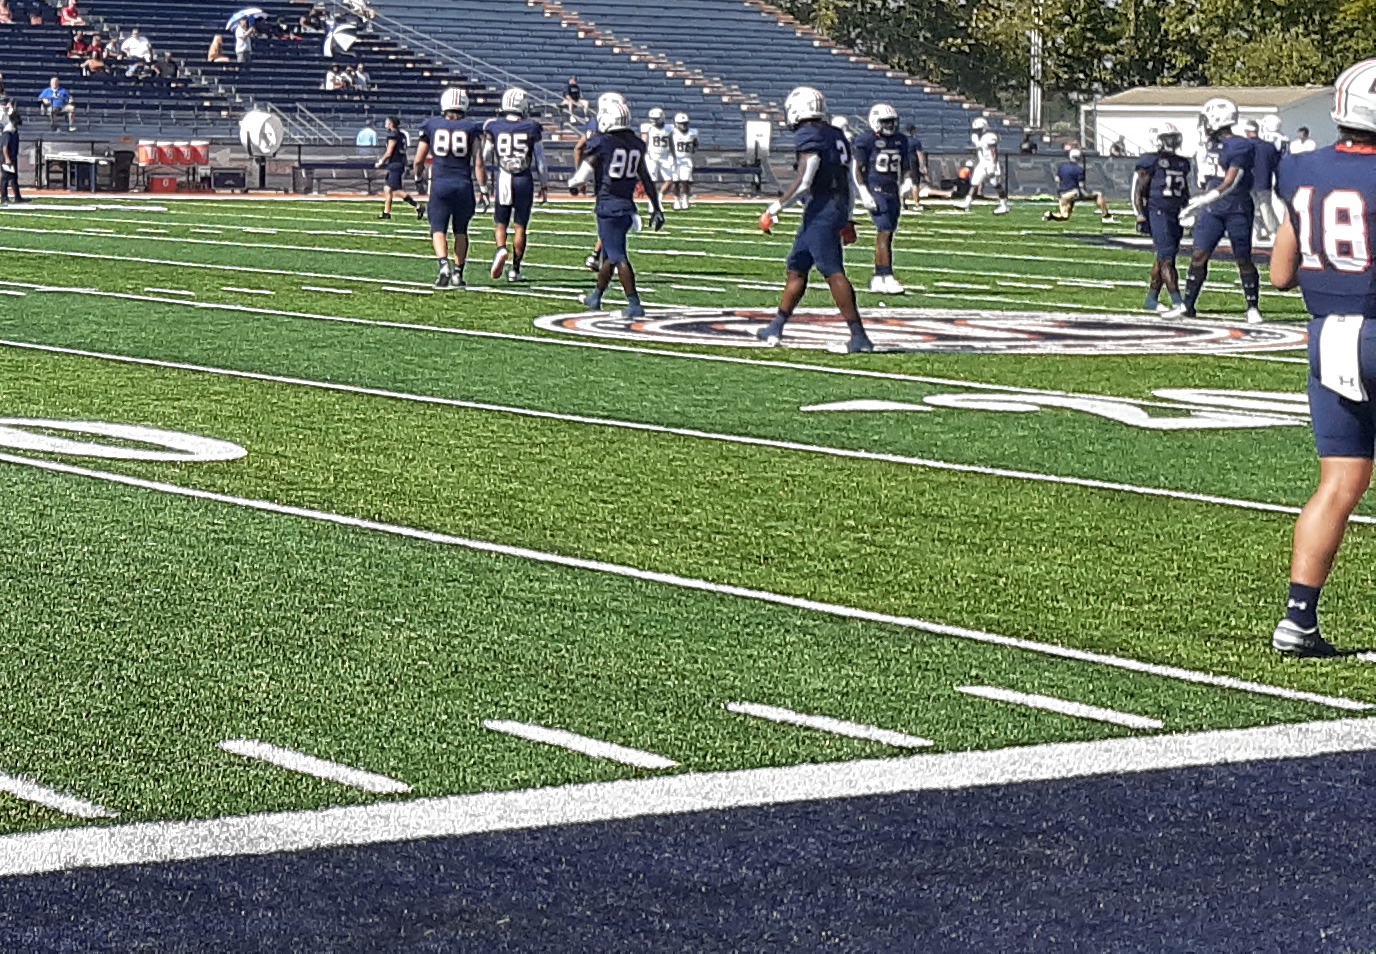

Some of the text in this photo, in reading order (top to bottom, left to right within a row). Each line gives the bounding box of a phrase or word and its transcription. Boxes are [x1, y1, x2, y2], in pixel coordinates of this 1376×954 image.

[432, 129, 468, 158] 88
[497, 132, 530, 159] 85
[608, 148, 641, 179] 80
[1291, 185, 1372, 275] 18
